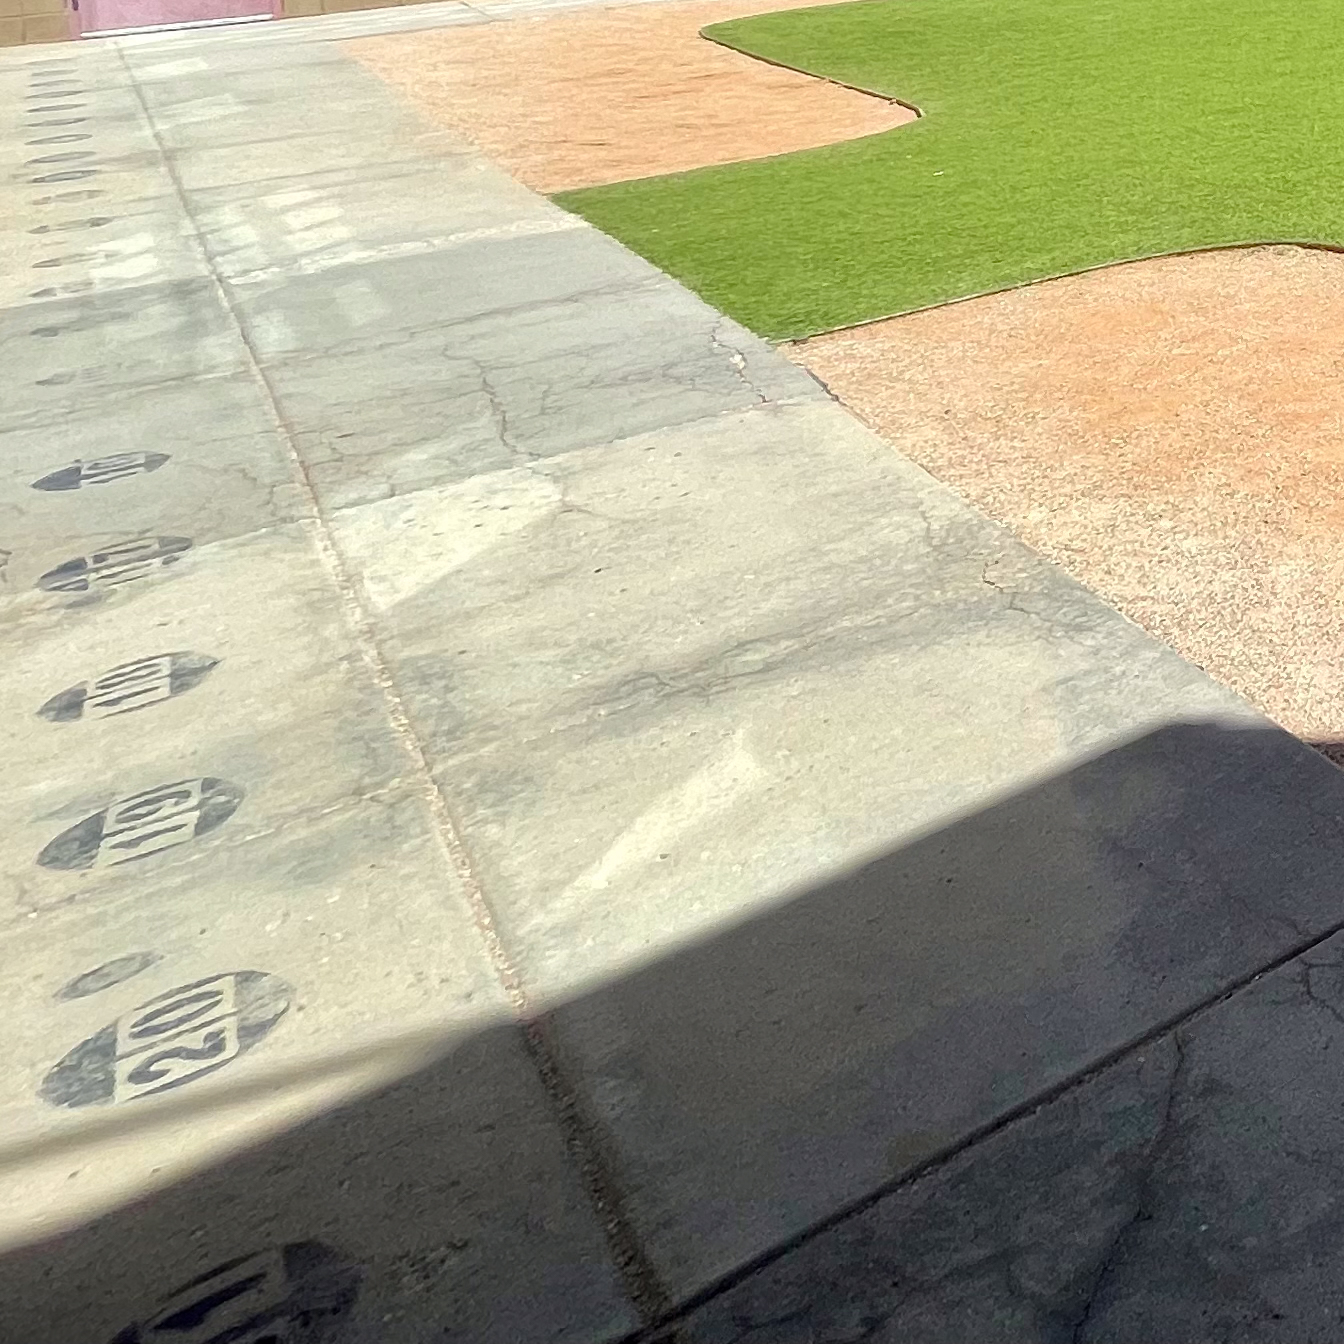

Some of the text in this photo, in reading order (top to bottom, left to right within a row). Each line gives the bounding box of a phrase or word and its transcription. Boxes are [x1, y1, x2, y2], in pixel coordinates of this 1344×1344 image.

[93, 662, 162, 709] 18
[108, 790, 193, 850] 19
[126, 989, 227, 1085] 20
